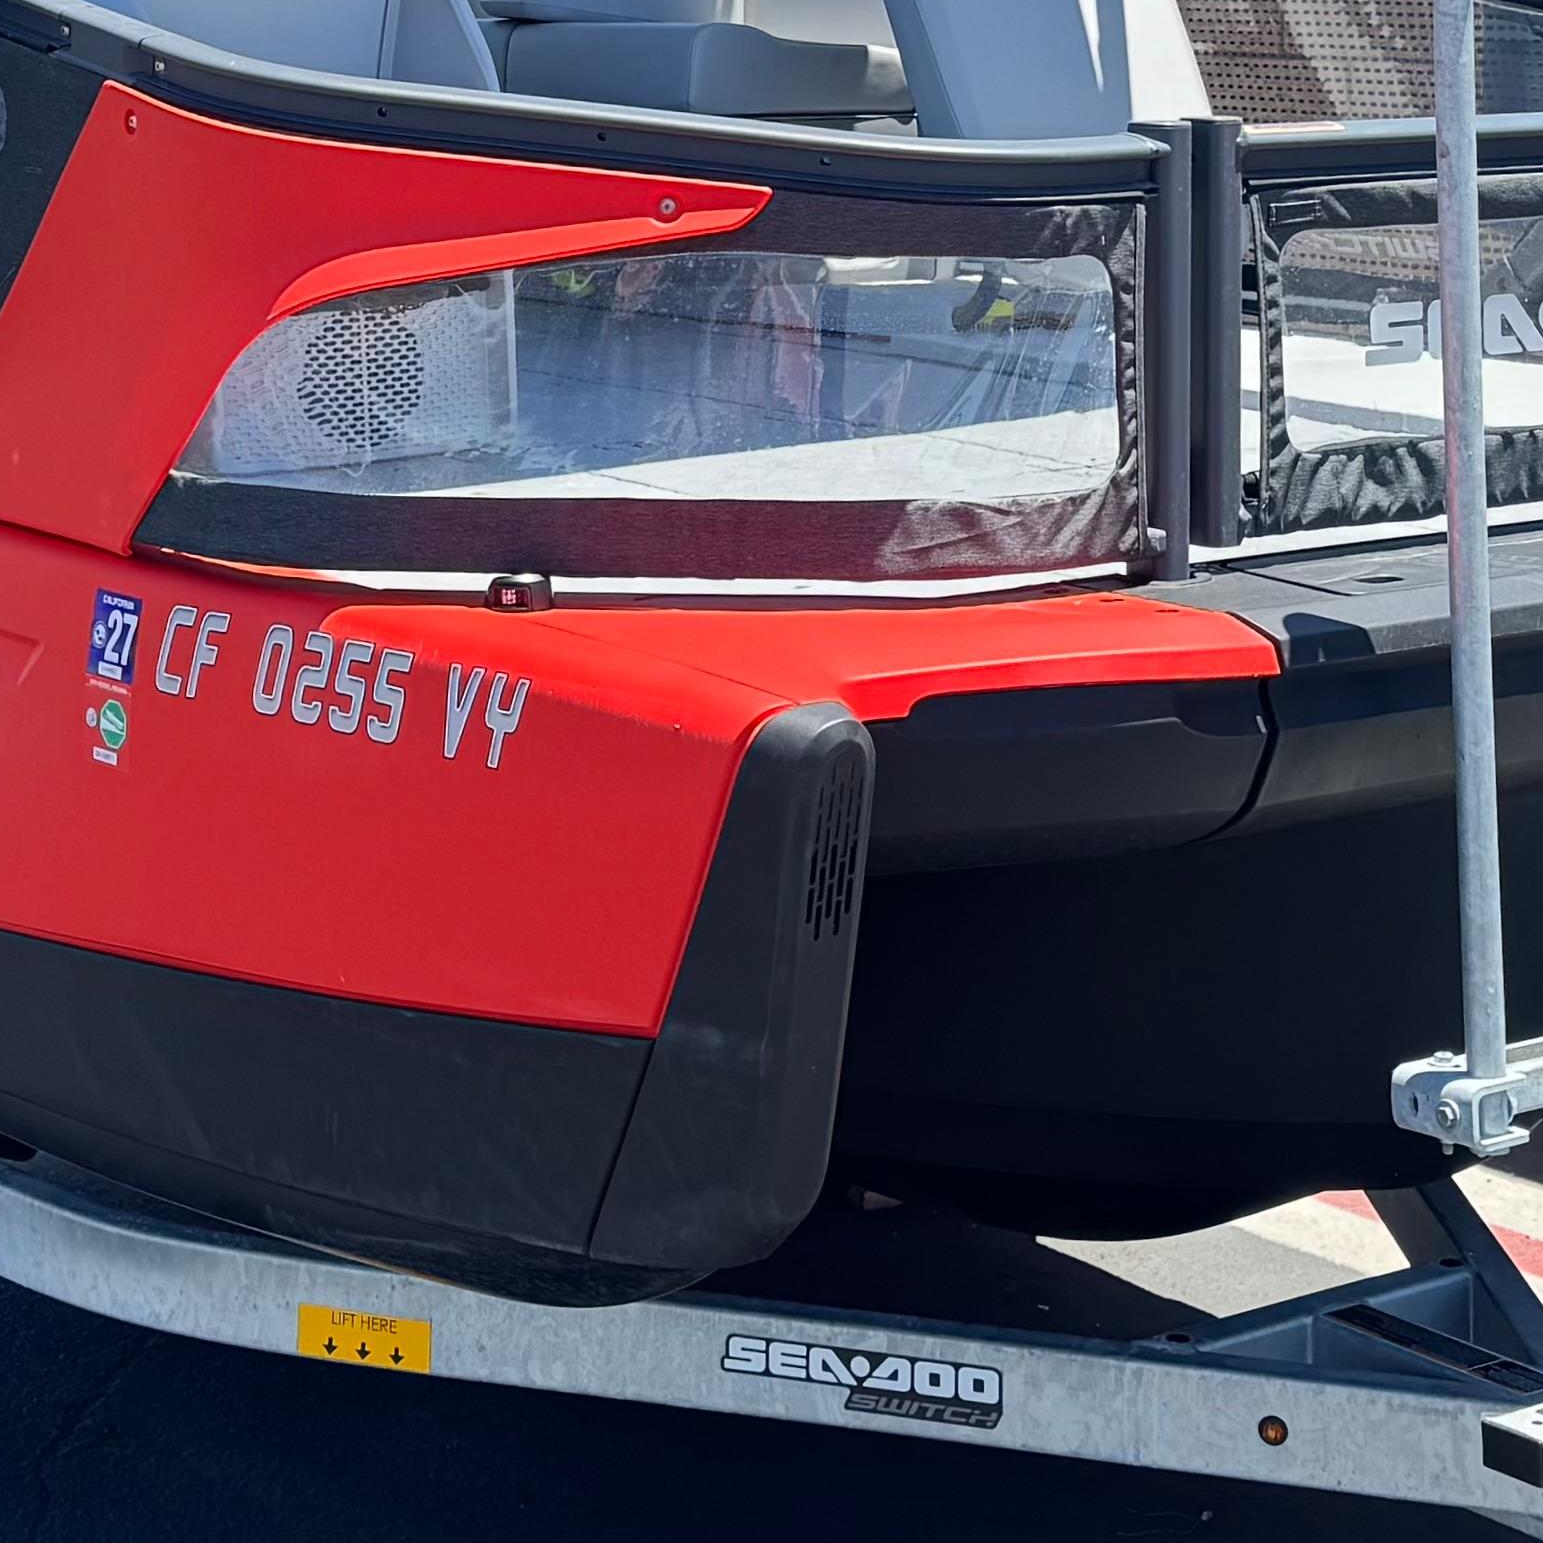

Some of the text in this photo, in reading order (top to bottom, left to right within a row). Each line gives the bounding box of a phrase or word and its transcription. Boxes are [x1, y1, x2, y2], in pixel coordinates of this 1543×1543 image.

[102, 609, 139, 666] 27
[154, 604, 532, 770] CF 0255 VY
[331, 1310, 398, 1335] LIFT HERE
[847, 1393, 999, 1427] SWITCH
